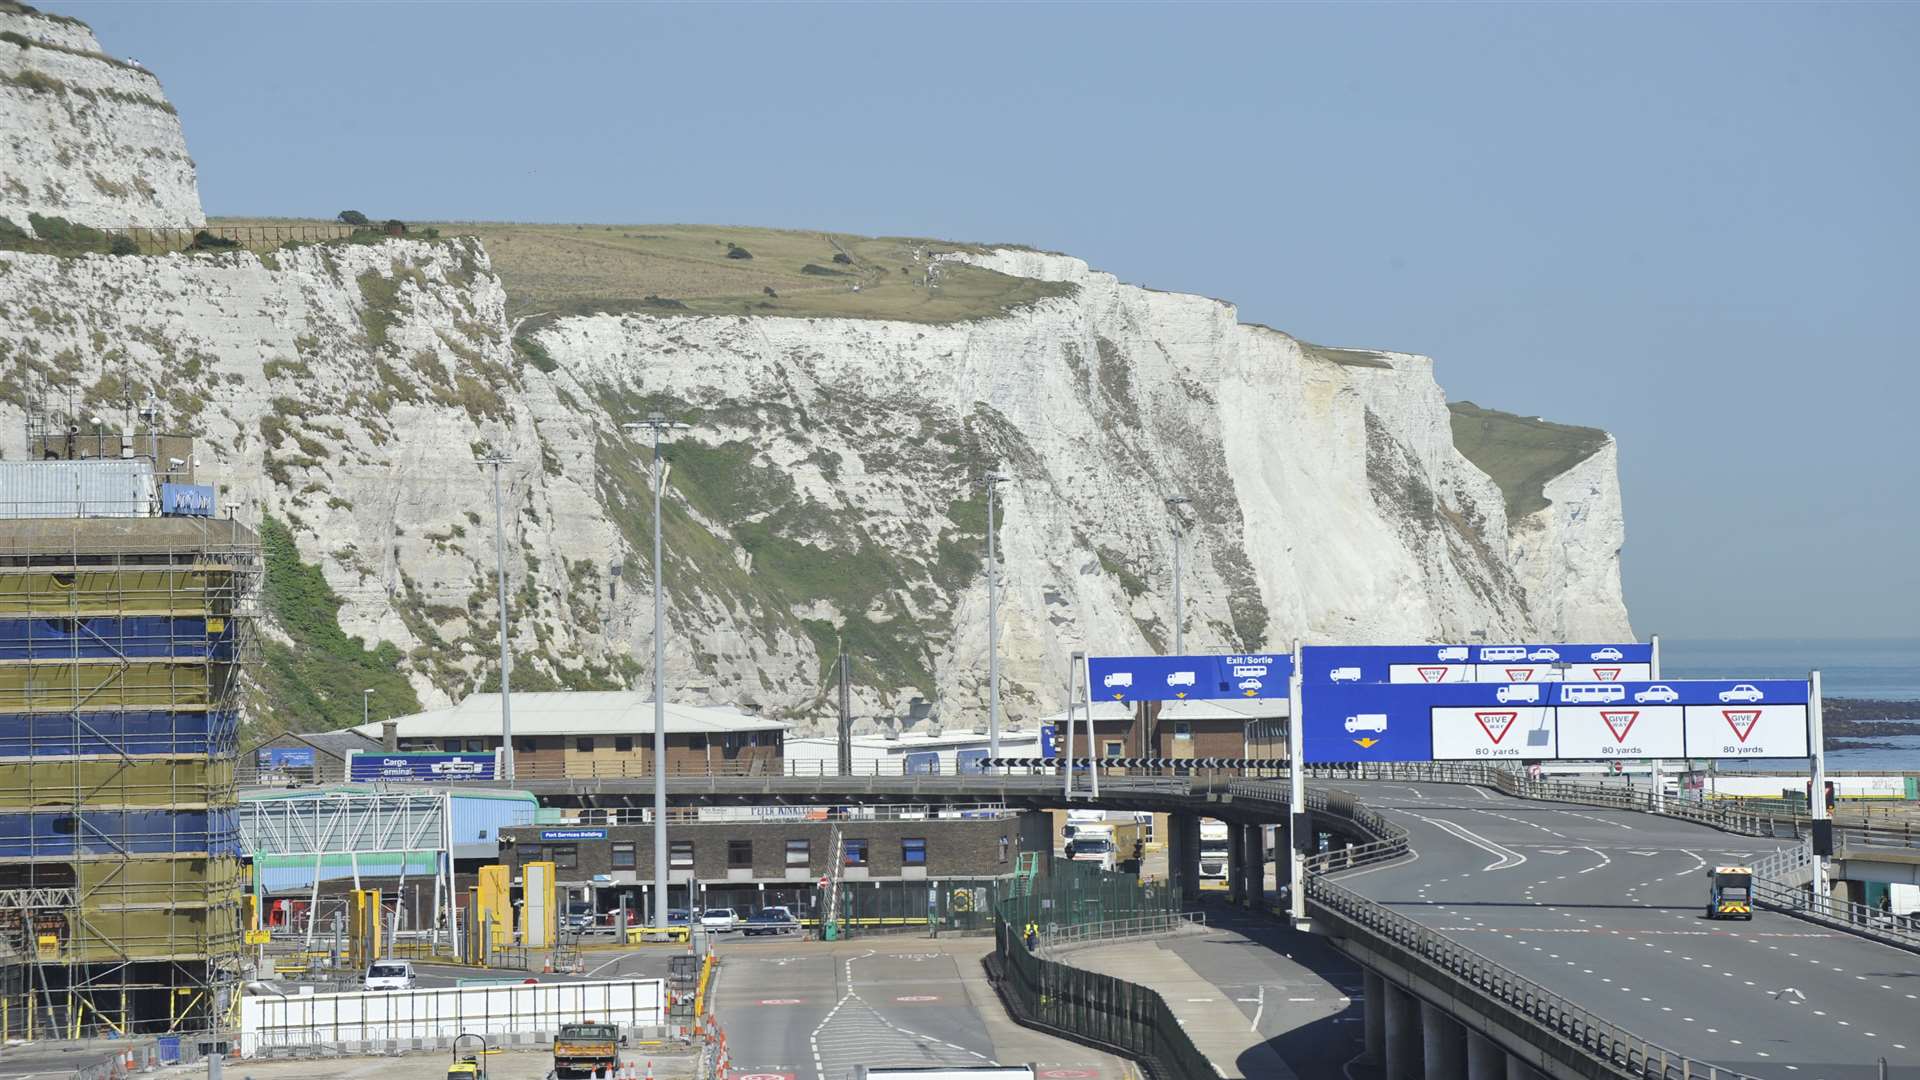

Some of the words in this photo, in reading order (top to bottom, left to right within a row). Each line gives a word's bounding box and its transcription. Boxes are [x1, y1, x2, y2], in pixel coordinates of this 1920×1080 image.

[1226, 656, 1273, 664] Exit/Sortie
[1493, 748, 1520, 756] yards
[1616, 747, 1642, 755] yards
[1737, 746, 1763, 754] yards
[384, 758, 407, 767] Cargo
